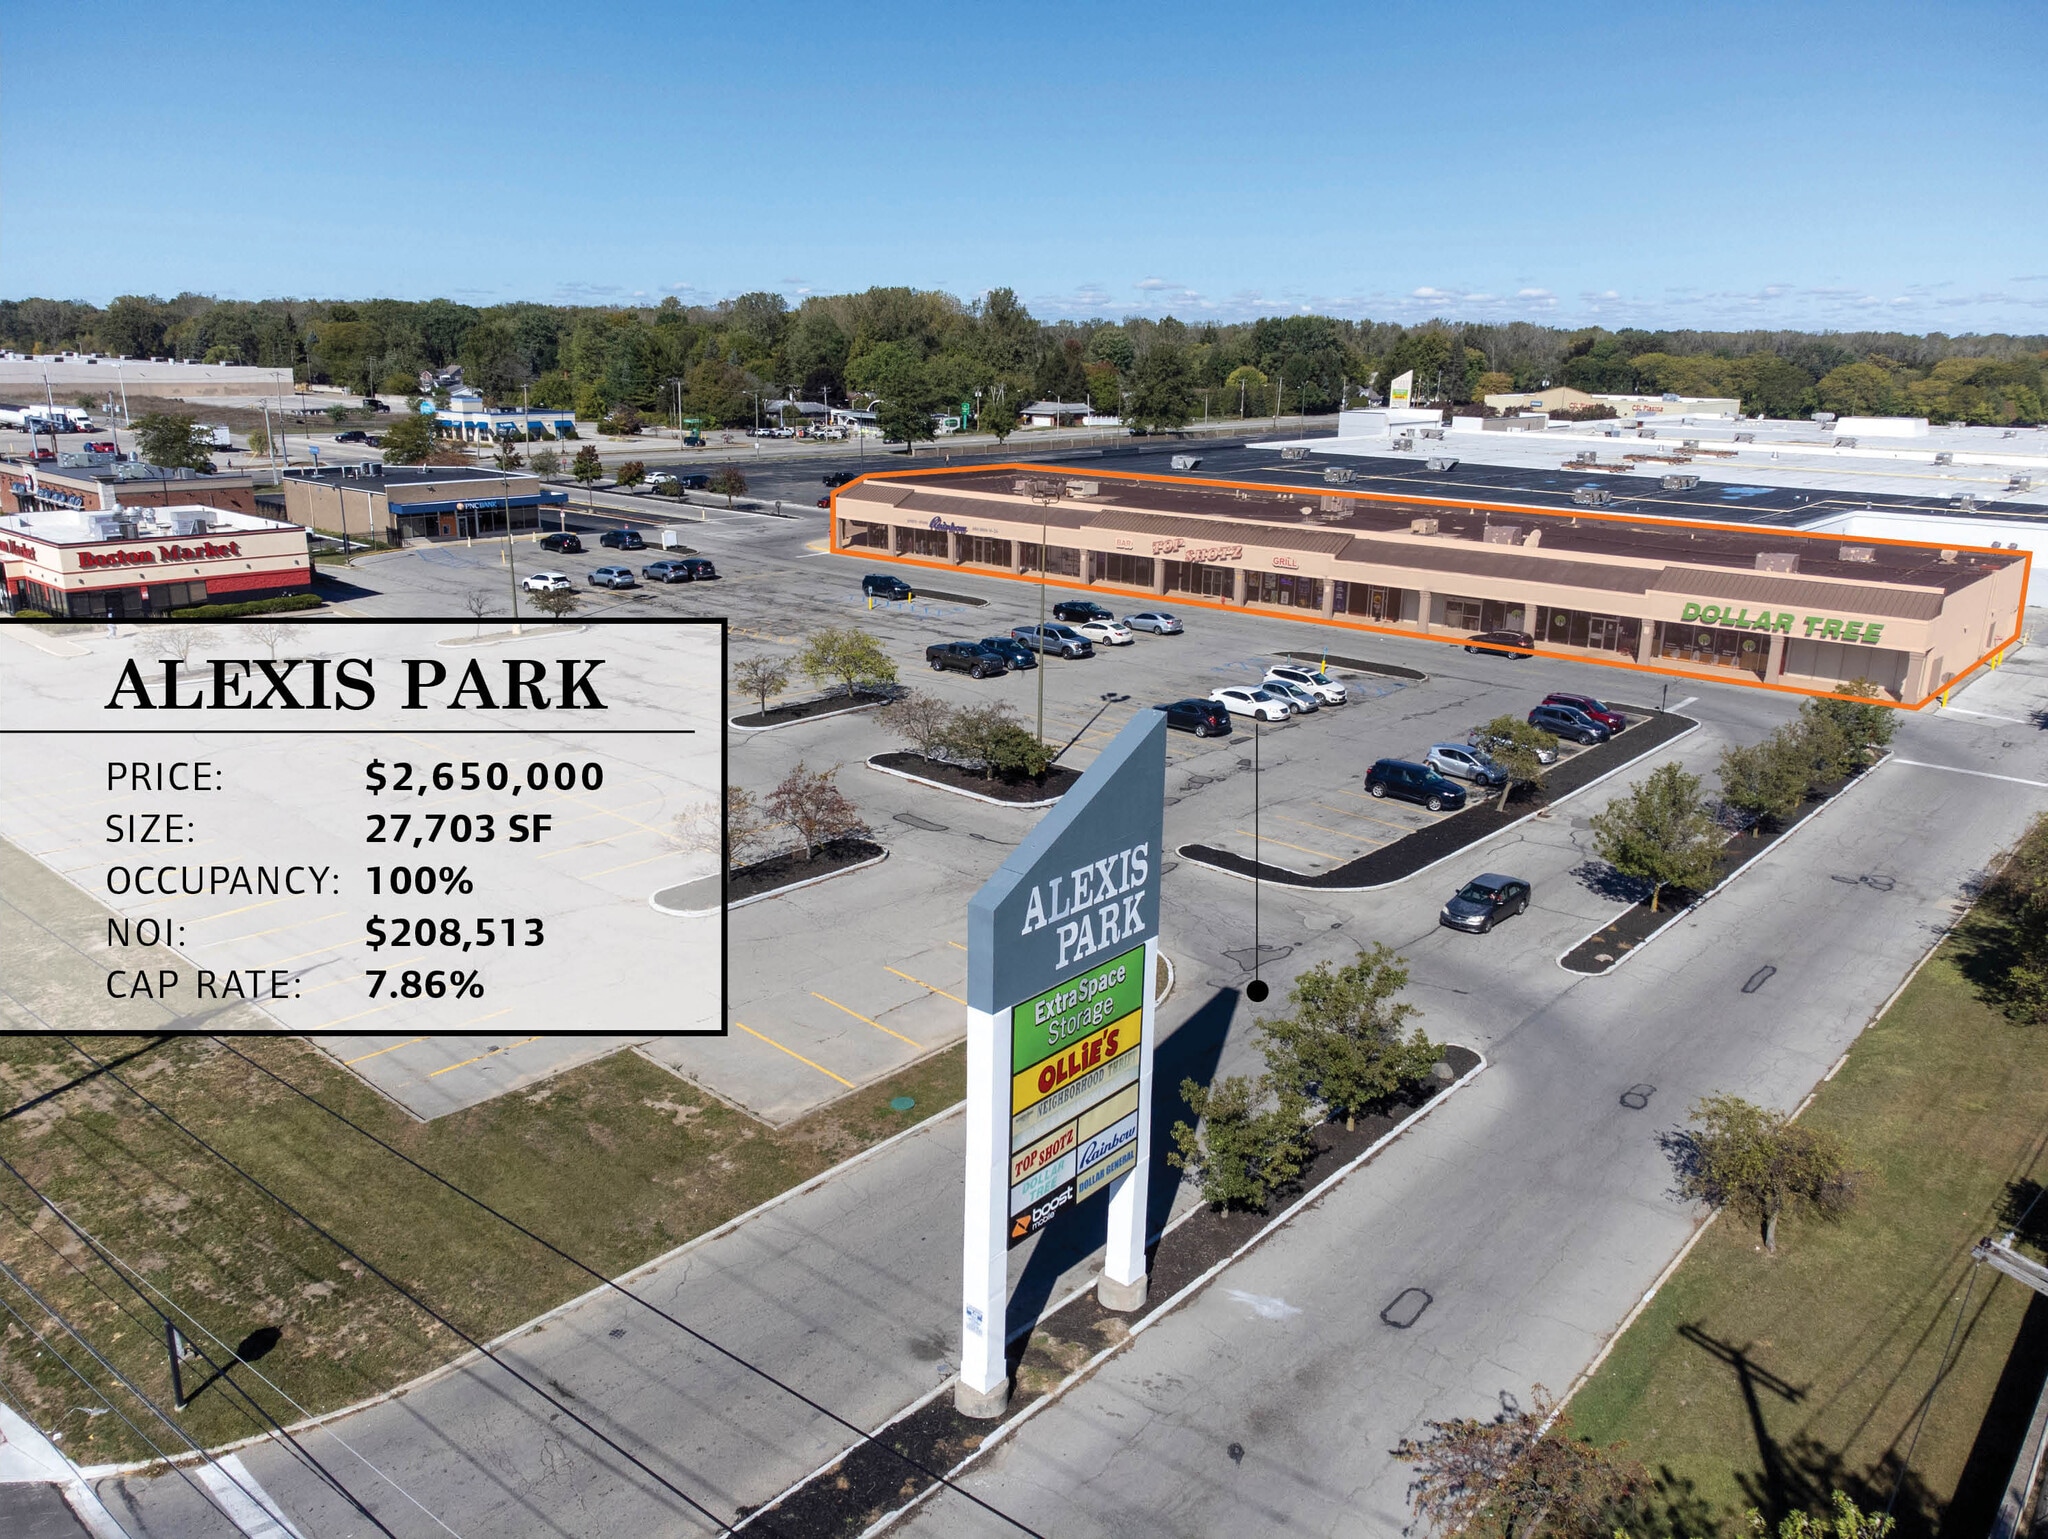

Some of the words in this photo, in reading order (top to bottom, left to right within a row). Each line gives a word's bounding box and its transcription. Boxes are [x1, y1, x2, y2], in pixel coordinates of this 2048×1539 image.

[929, 516, 968, 534] Rainbow
[77, 548, 156, 569] Boston
[157, 540, 242, 563] Market
[1116, 538, 1133, 549] BAR
[1152, 538, 1185, 555] TOP
[1185, 545, 1243, 563] SHOTZ
[1272, 556, 1299, 569] GRILL
[1681, 602, 1795, 634] DOLLAR
[1803, 616, 1885, 645] TREE
[1021, 842, 1149, 935] ALEXIS
[1055, 890, 1146, 970] PARK
[1048, 997, 1114, 1044] Storage
[1037, 1069, 1105, 1116] NEIGHBORHOOD
[1015, 1150, 1038, 1178] TOP
[1038, 1129, 1074, 1166] SHOTZ
[1080, 1126, 1136, 1170] Rainbow
[1022, 1159, 1065, 1194] DOLLAR
[1030, 1177, 1057, 1201] TREE
[1079, 1168, 1105, 1193] DOLLAR
[1106, 1150, 1134, 1176] GENERAL
[1032, 1185, 1074, 1222] boost
[1032, 1211, 1056, 1231] mobile
